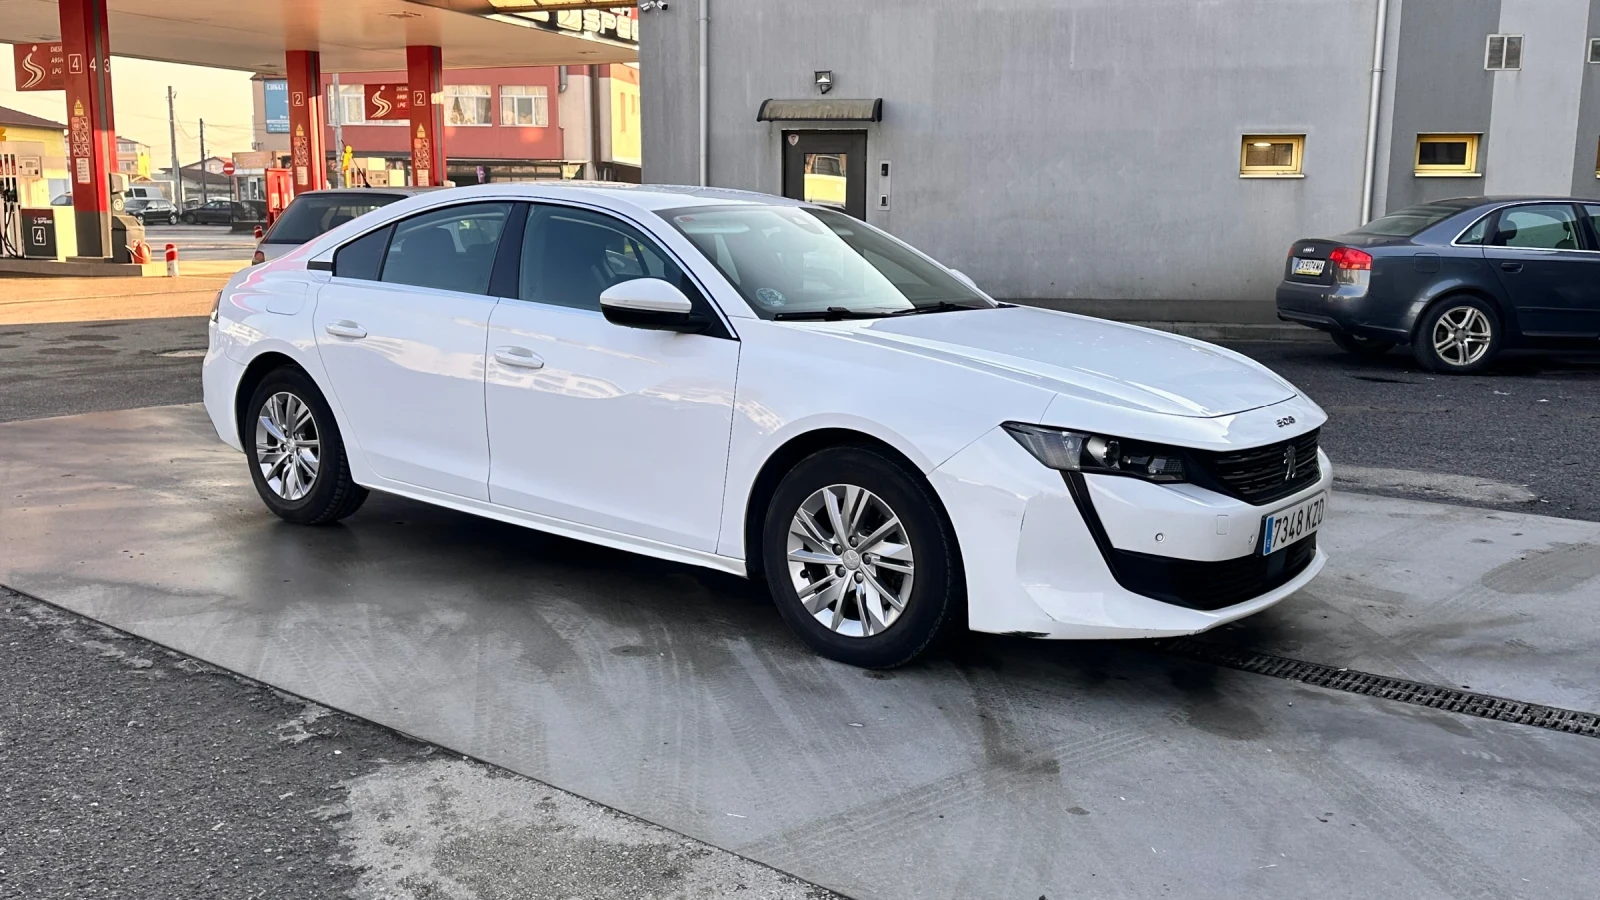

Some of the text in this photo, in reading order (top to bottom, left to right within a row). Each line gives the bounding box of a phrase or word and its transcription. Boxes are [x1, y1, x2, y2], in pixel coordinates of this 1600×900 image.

[72, 56, 79, 71] 4
[89, 57, 97, 72] 4
[104, 58, 110, 73] 3
[295, 93, 301, 104] 2
[416, 92, 423, 104] 2
[36, 229, 42, 242] 4
[1273, 497, 1325, 548] 7348 KZD
